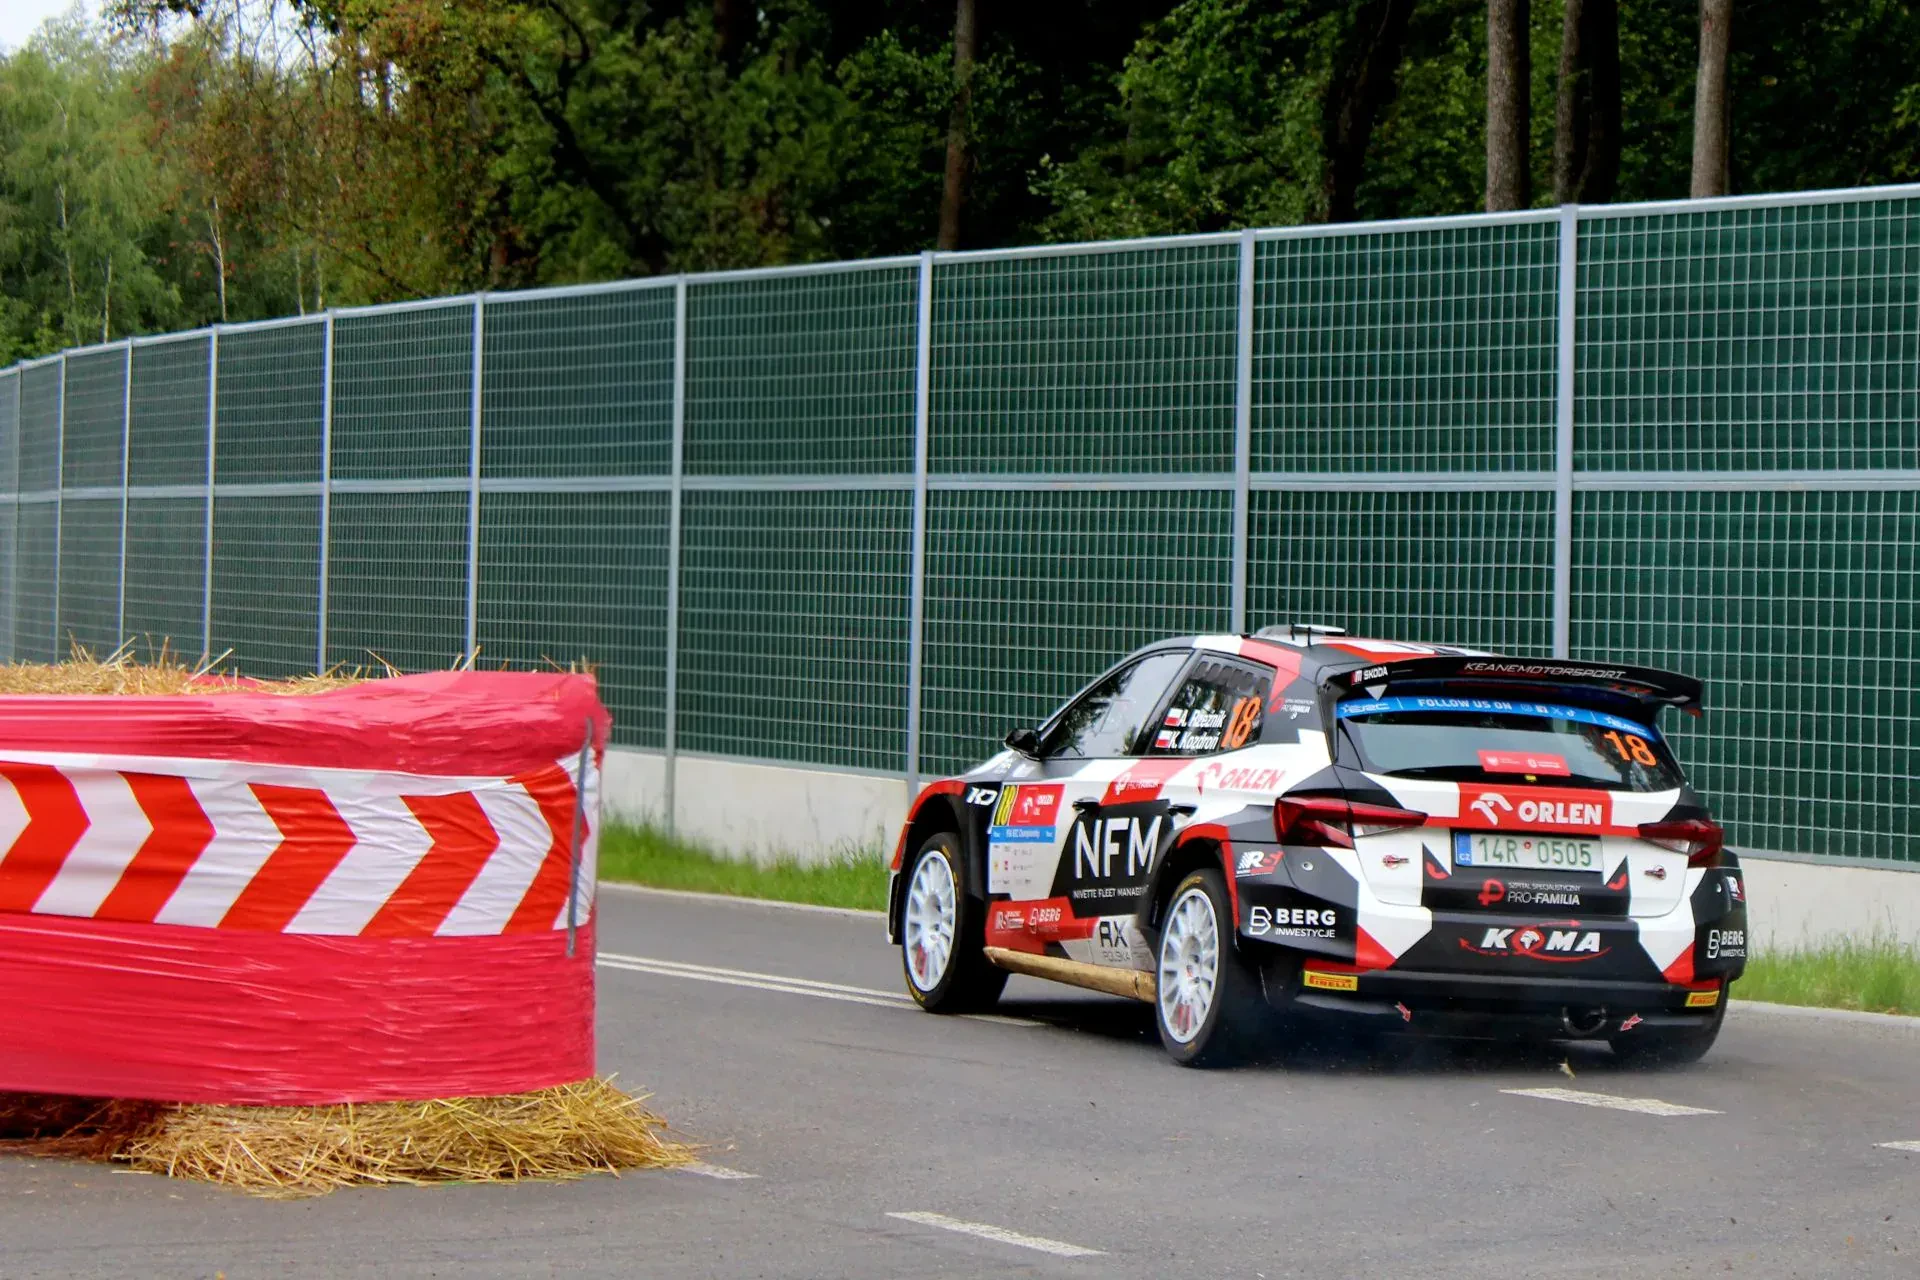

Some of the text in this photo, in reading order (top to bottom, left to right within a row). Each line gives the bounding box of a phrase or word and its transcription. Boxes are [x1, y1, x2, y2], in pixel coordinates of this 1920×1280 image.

[1418, 699, 1513, 710] FOLLOW US ON
[1180, 709, 1188, 727] A.
[1221, 696, 1262, 749] 18
[1168, 731, 1181, 749] K.
[1604, 730, 1657, 766] 18
[1219, 768, 1287, 790] ORLEN
[1518, 800, 1602, 825] ORLEN
[1075, 815, 1163, 879] NFM
[1478, 836, 1592, 867] 14R 0505
[1459, 853, 1471, 862] CZ
[1098, 888, 1116, 898] FLEET
[1507, 891, 1580, 905] PRO-FAMILIA
[1039, 908, 1061, 922] BERG
[1276, 908, 1336, 926] BERG
[1275, 928, 1336, 938] INWESTYCJE
[1721, 930, 1744, 945] BERG
